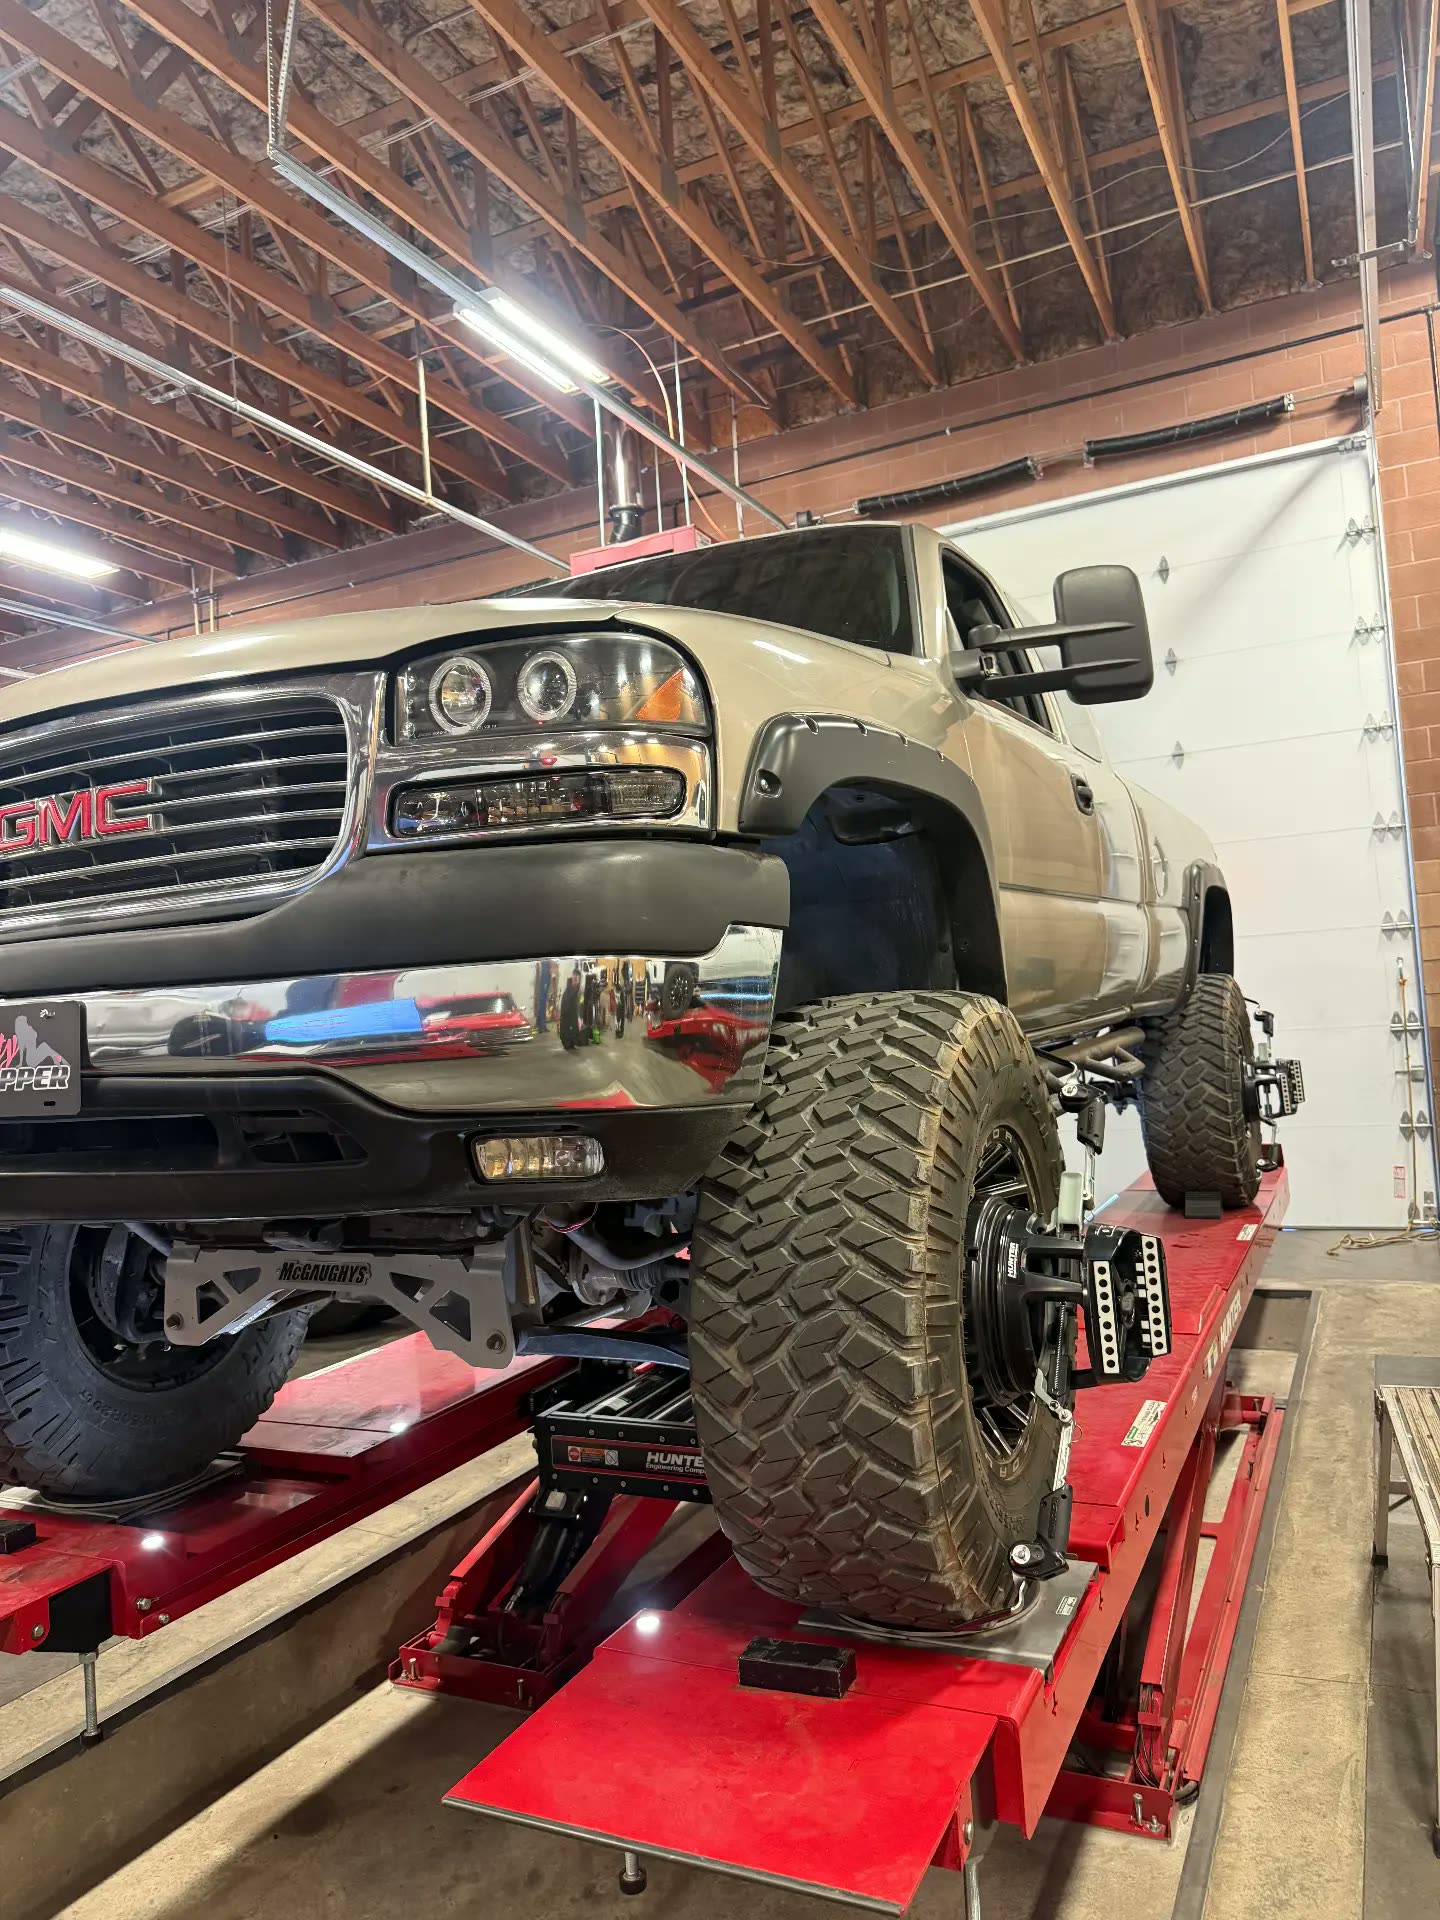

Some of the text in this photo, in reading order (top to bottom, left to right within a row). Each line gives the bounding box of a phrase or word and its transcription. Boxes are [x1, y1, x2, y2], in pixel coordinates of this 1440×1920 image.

[0, 778, 154, 852] GMC
[0, 1065, 71, 1091] PPER
[1007, 1241, 1016, 1278] HUNTER
[1220, 1288, 1242, 1354] HUNTER
[645, 1462, 707, 1474] Engineering Comp
[646, 1451, 705, 1468] HUNTE
